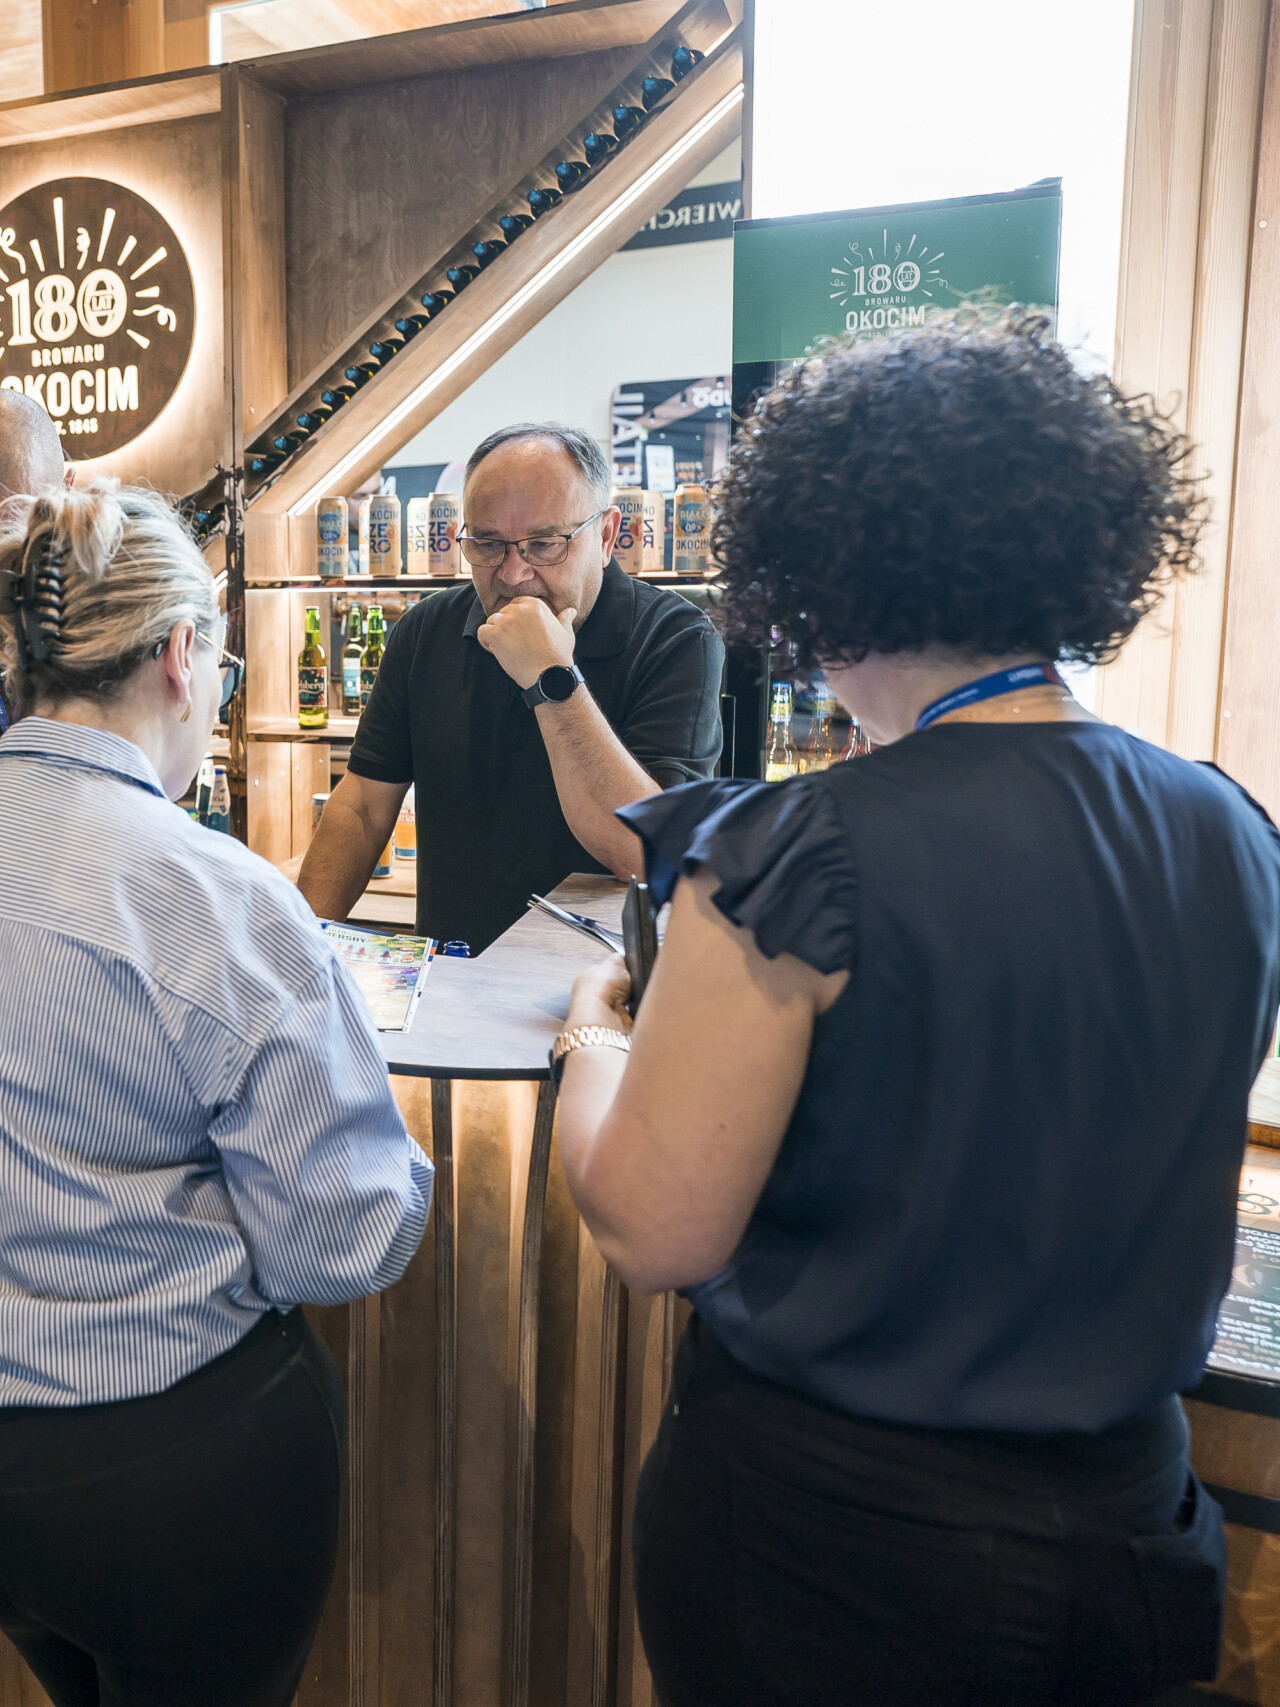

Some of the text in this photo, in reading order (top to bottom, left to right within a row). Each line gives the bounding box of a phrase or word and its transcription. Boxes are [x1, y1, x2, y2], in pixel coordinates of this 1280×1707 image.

[852, 261, 921, 296] 180
[901, 272, 913, 281] LAT
[6, 268, 128, 346] 180
[91, 293, 114, 311] LAT
[865, 295, 907, 306] BROWARU
[845, 305, 926, 331] OKOCIM
[31, 343, 105, 368] BROWARU
[0, 365, 139, 417] KOCIM
